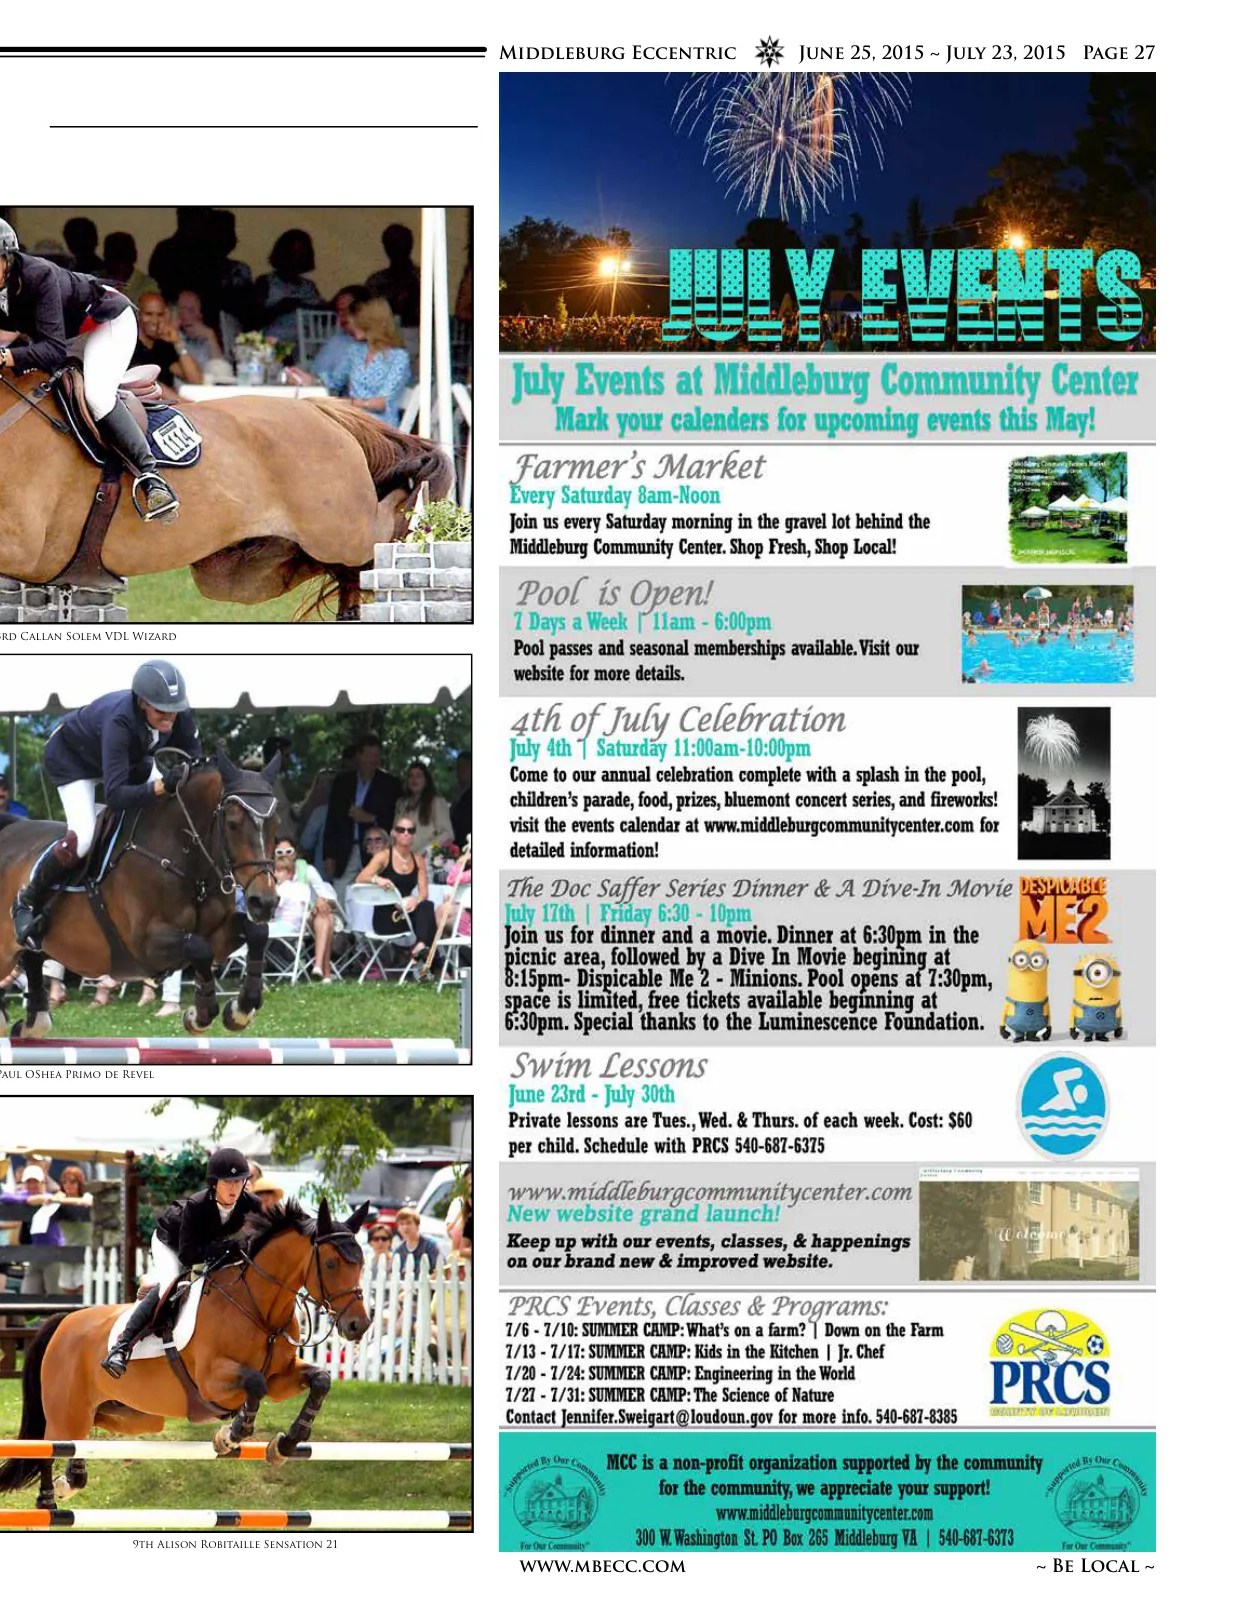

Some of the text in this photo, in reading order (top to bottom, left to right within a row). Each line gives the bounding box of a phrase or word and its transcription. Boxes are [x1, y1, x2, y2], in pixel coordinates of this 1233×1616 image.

[499, 44, 737, 60] MIDDLEBURG ECCENTRIC
[799, 44, 1156, 64] JUNE 25, 2015 JULY 23, 2015 PAGE 27
[662, 248, 1144, 342] JULY EVENTS
[511, 362, 1139, 404] July Events at Middleburg Community Center
[555, 406, 1095, 438] Mark your calenders for upcoming events this May!
[508, 449, 768, 486] Farmer's Market
[20, 631, 62, 641] CALLAN
[66, 631, 102, 641] SOLEM
[104, 631, 130, 641] VDL
[132, 631, 177, 641] WIZARD
[513, 664, 685, 682] website for more details.
[509, 840, 659, 859] detailed information!
[1019, 876, 1108, 895] DESPICABLE
[25, 1069, 63, 1079] OSHEA
[65, 1069, 102, 1079] PRIMO
[105, 1070, 119, 1079] DE
[122, 1069, 155, 1079] REVEL
[509, 1084, 675, 1107] June 23rd July 30th
[508, 1136, 826, 1158] per child. Schedule with PRCS 540-687-6375
[989, 1360, 1111, 1405] PRCS
[505, 1407, 958, 1427] Contact Jennifer.Sweigart@loudoun.gov for more info. 540-687-8385
[716, 1504, 933, 1524] www.middleburgcommunitycenter.com
[132, 1539, 337, 1549] 9TH ALISON ROBITAILLE SENSATION 21
[1052, 1557, 1140, 1573] BE LOCAL
